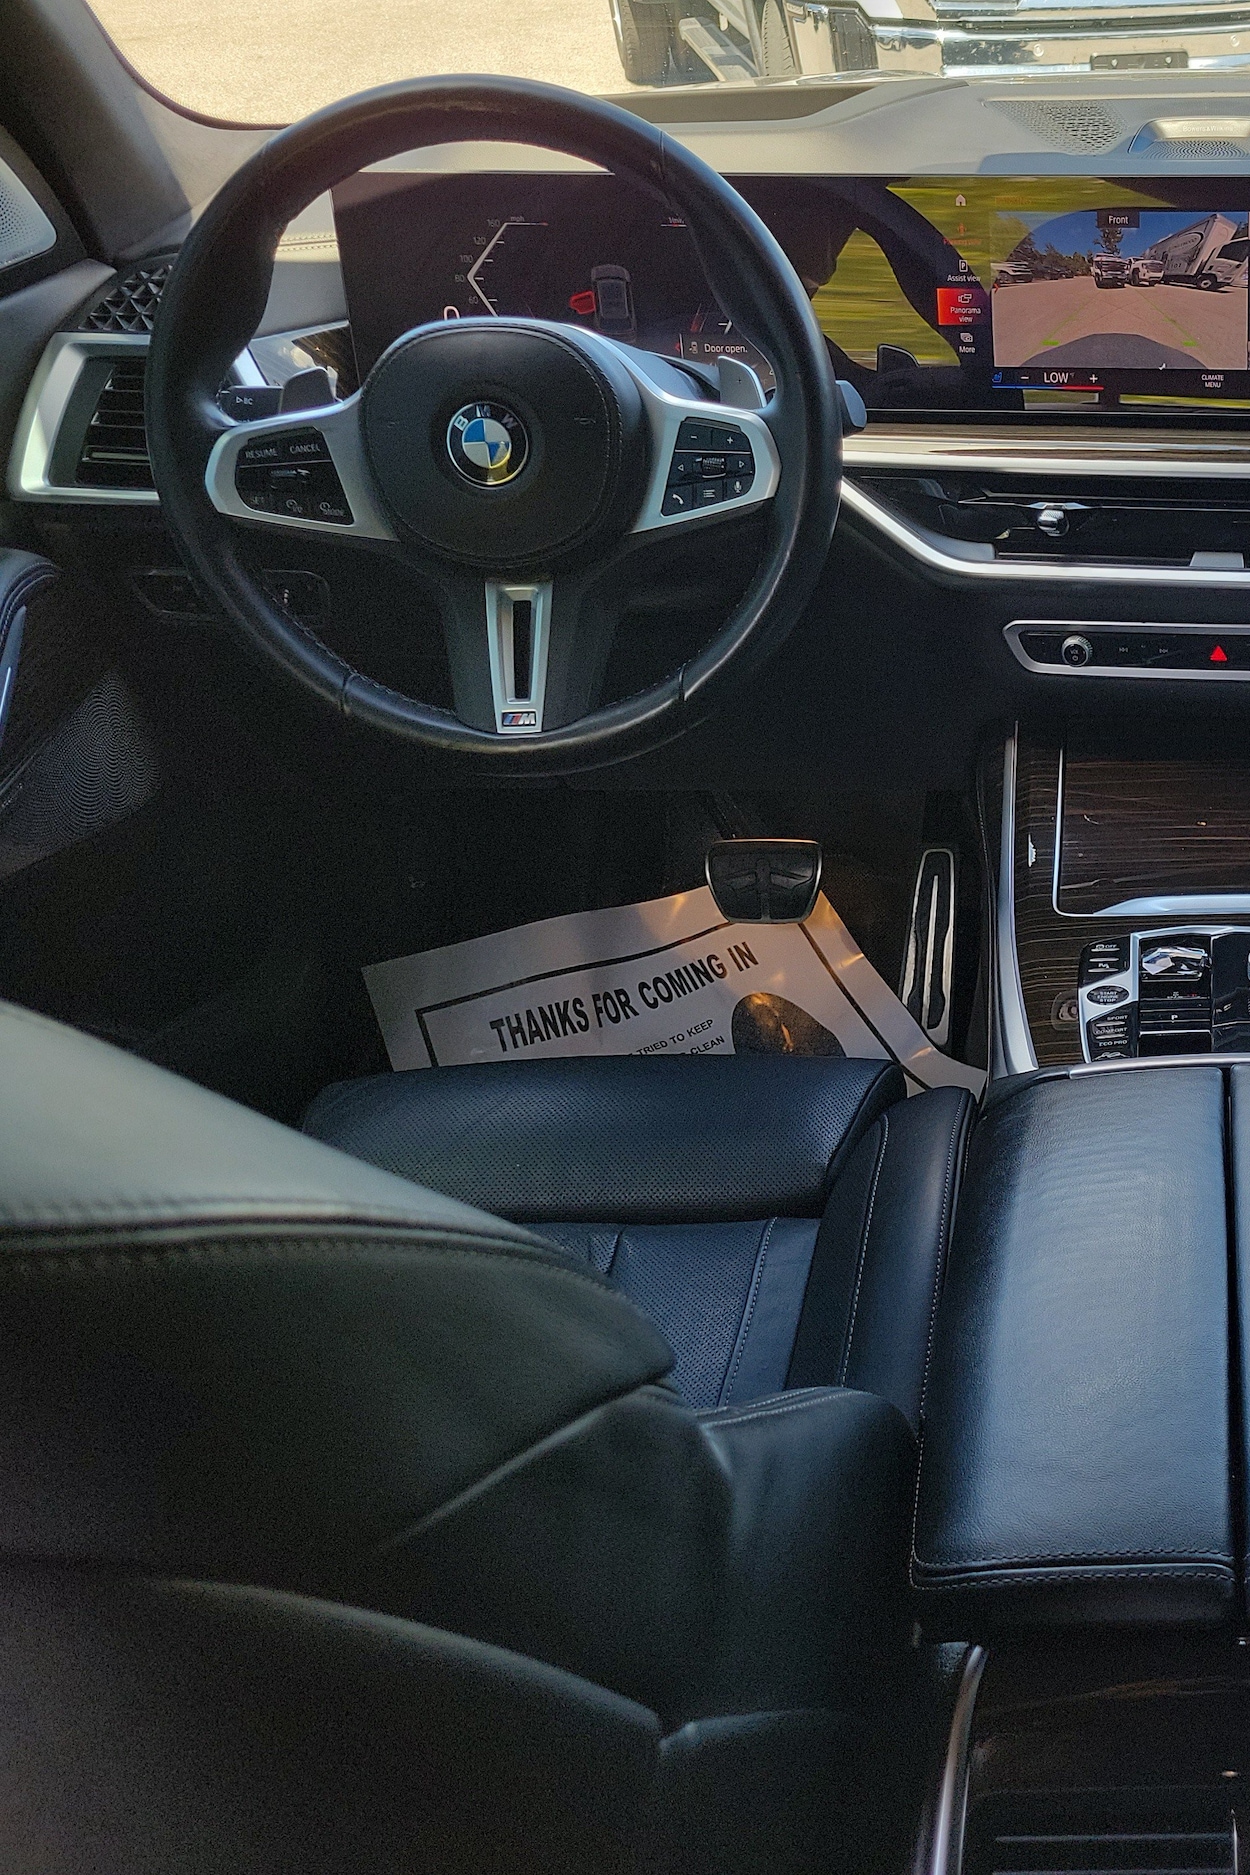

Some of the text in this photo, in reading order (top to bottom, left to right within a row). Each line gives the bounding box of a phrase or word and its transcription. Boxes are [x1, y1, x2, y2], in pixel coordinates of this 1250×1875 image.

[1108, 215, 1129, 224] Front
[473, 236, 486, 245] 120
[460, 254, 473, 263] 100
[454, 274, 465, 283] 80
[947, 274, 981, 282] Assist view
[468, 296, 479, 304] 60
[950, 306, 981, 314] Panorama
[959, 315, 973, 323] view
[704, 343, 748, 354] Door open.
[1043, 372, 1069, 383] LOW
[454, 405, 518, 431] BMW
[245, 444, 321, 459] RESUME CANCEL
[489, 941, 759, 1052] THANKS FOR COMING IN
[636, 1019, 714, 1055] TRIED TO KEEP
[690, 1035, 725, 1055] CLEAN
